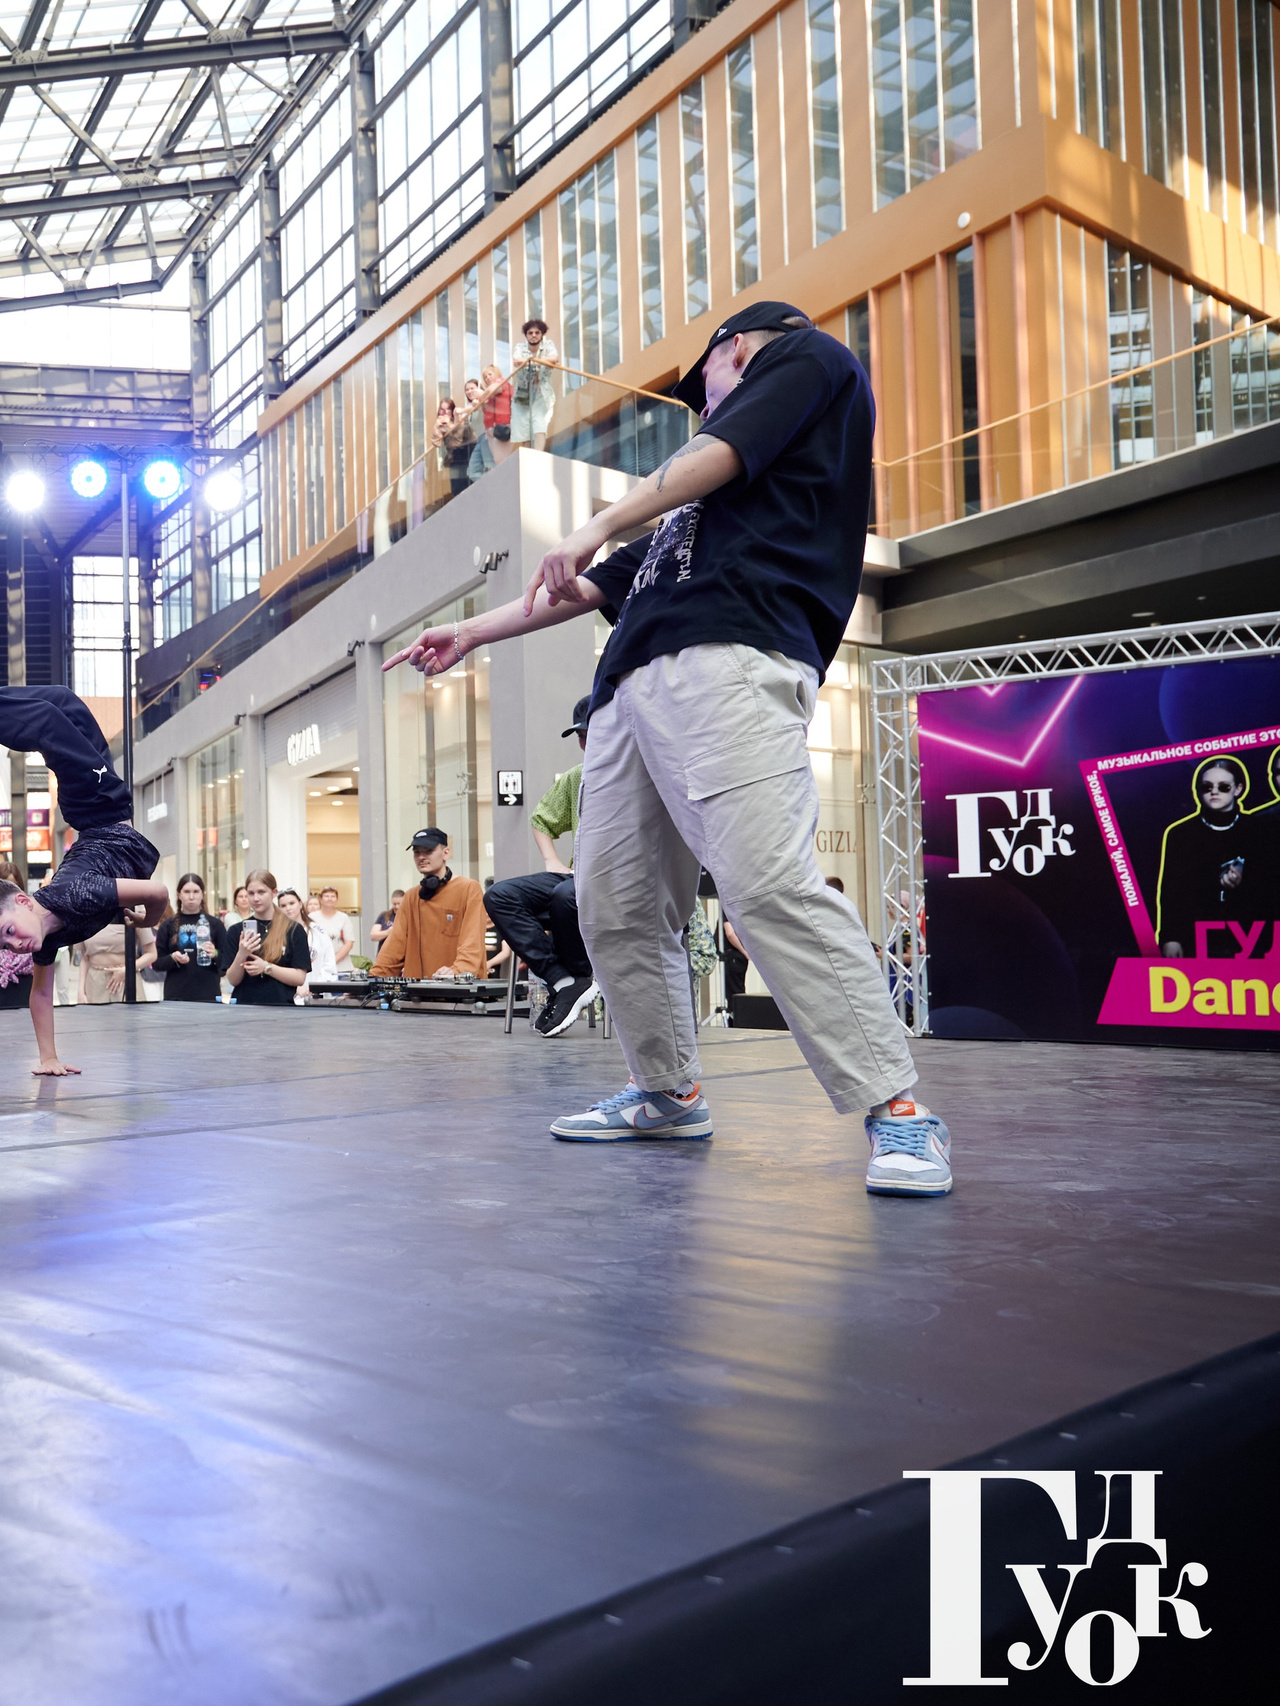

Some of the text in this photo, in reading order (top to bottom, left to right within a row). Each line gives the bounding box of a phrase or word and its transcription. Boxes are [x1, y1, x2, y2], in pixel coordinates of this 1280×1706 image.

[1097, 744, 1193, 771] МУЗЫКАЛЬНОЕ
[1193, 732, 1258, 754] СОБЫТИЕ
[1086, 770, 1139, 907] ПОЖАЛУЙ, САМОЕ ЯРКОЕ,
[1148, 966, 1280, 1017] Dan
